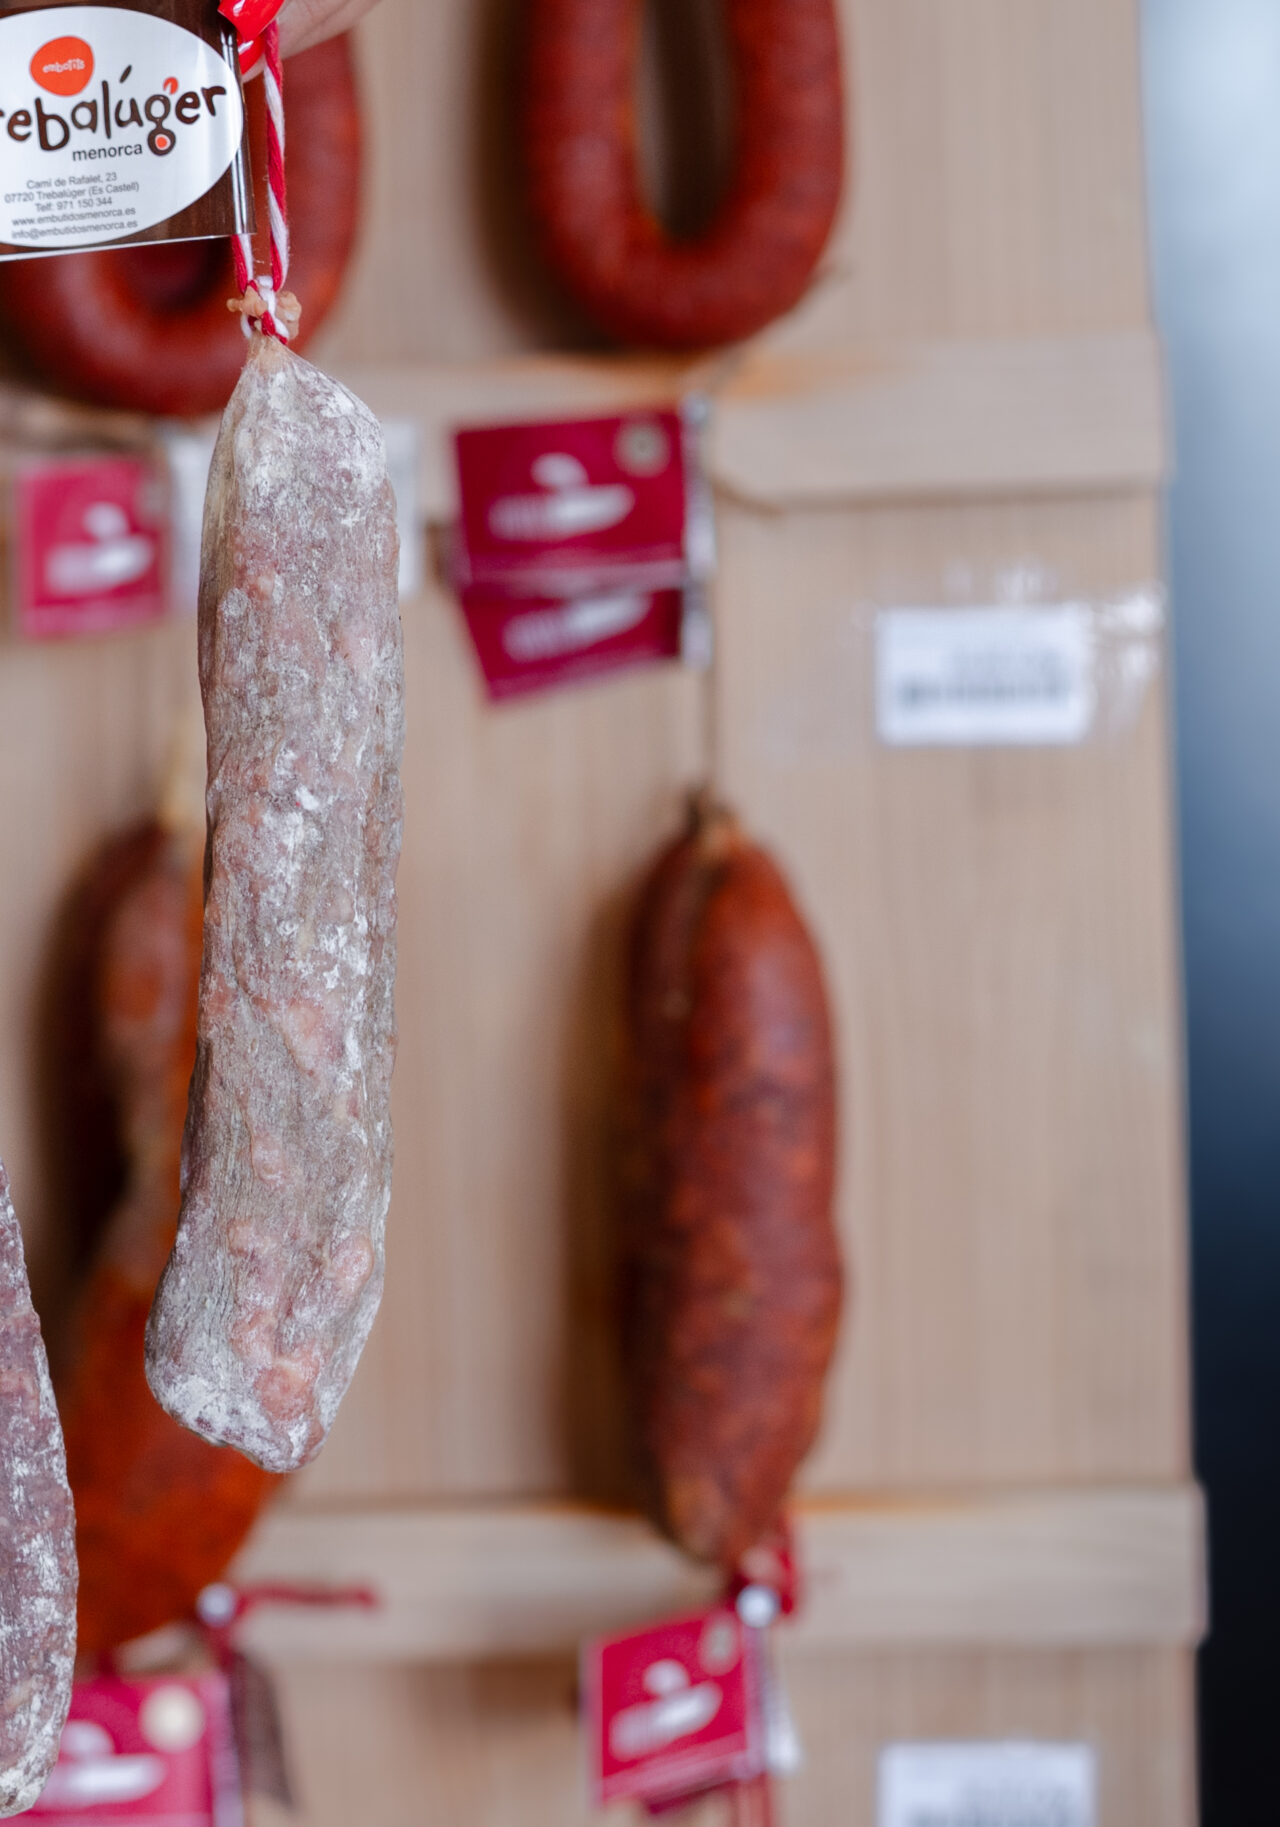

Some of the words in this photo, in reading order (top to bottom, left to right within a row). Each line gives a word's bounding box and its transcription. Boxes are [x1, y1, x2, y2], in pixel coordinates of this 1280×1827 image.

[72, 143, 143, 162] menorca
[54, 177, 67, 188] de
[105, 172, 118, 182] 23
[4, 192, 35, 204] 07720
[36, 187, 86, 201] Trebalúger
[88, 184, 104, 197] (Es
[105, 181, 140, 194] Castell)
[56, 200, 74, 211] 971
[77, 198, 94, 209] 150
[96, 196, 113, 207] 344
[11, 206, 137, 227] www.embutidosmenorca.es
[11, 219, 139, 240] info@embutidosmenorca.es
